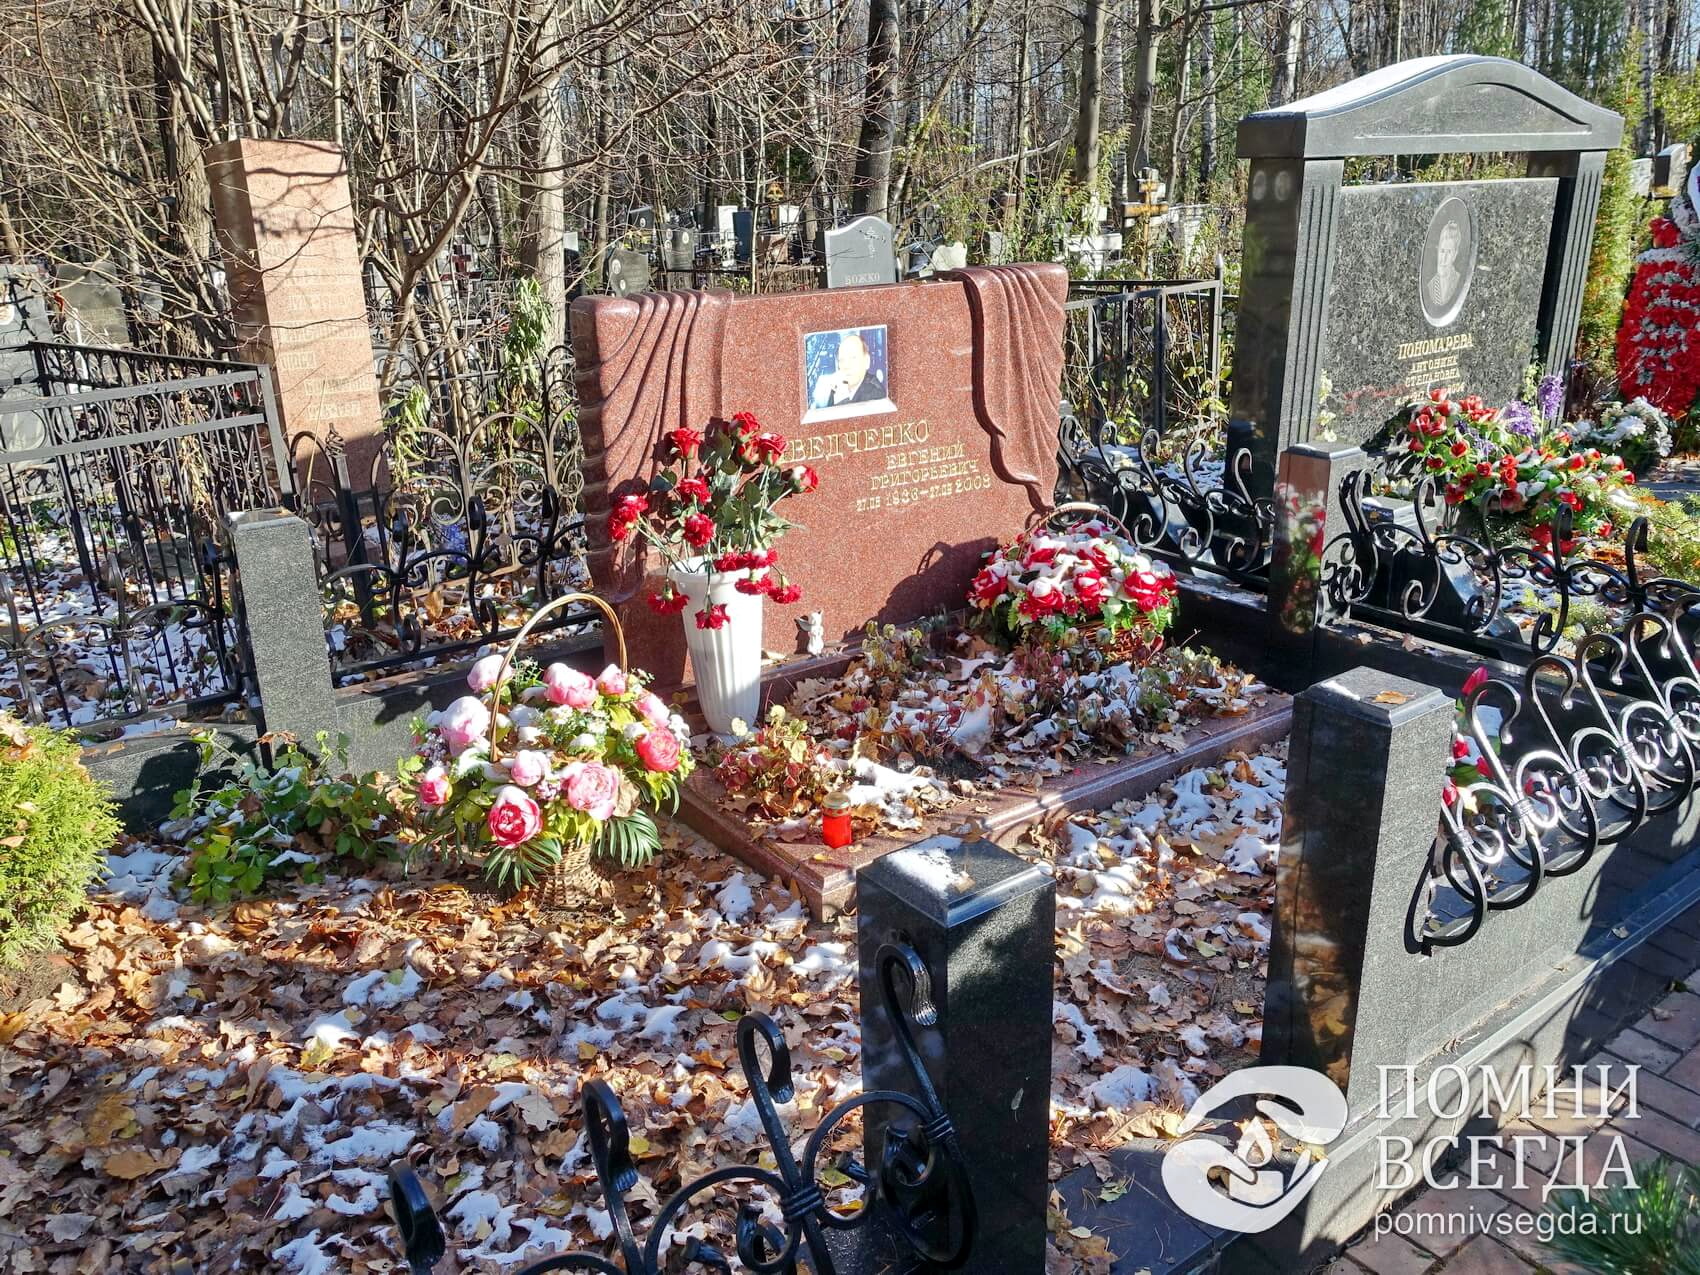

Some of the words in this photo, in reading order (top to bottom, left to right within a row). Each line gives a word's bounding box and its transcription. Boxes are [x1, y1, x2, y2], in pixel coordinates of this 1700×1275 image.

[1397, 333, 1474, 360] ПОНОМАРЕВА
[886, 441, 965, 470] ЕВГЕНИЙ
[871, 459, 979, 490] ГРИГОРЬЕВИЧ
